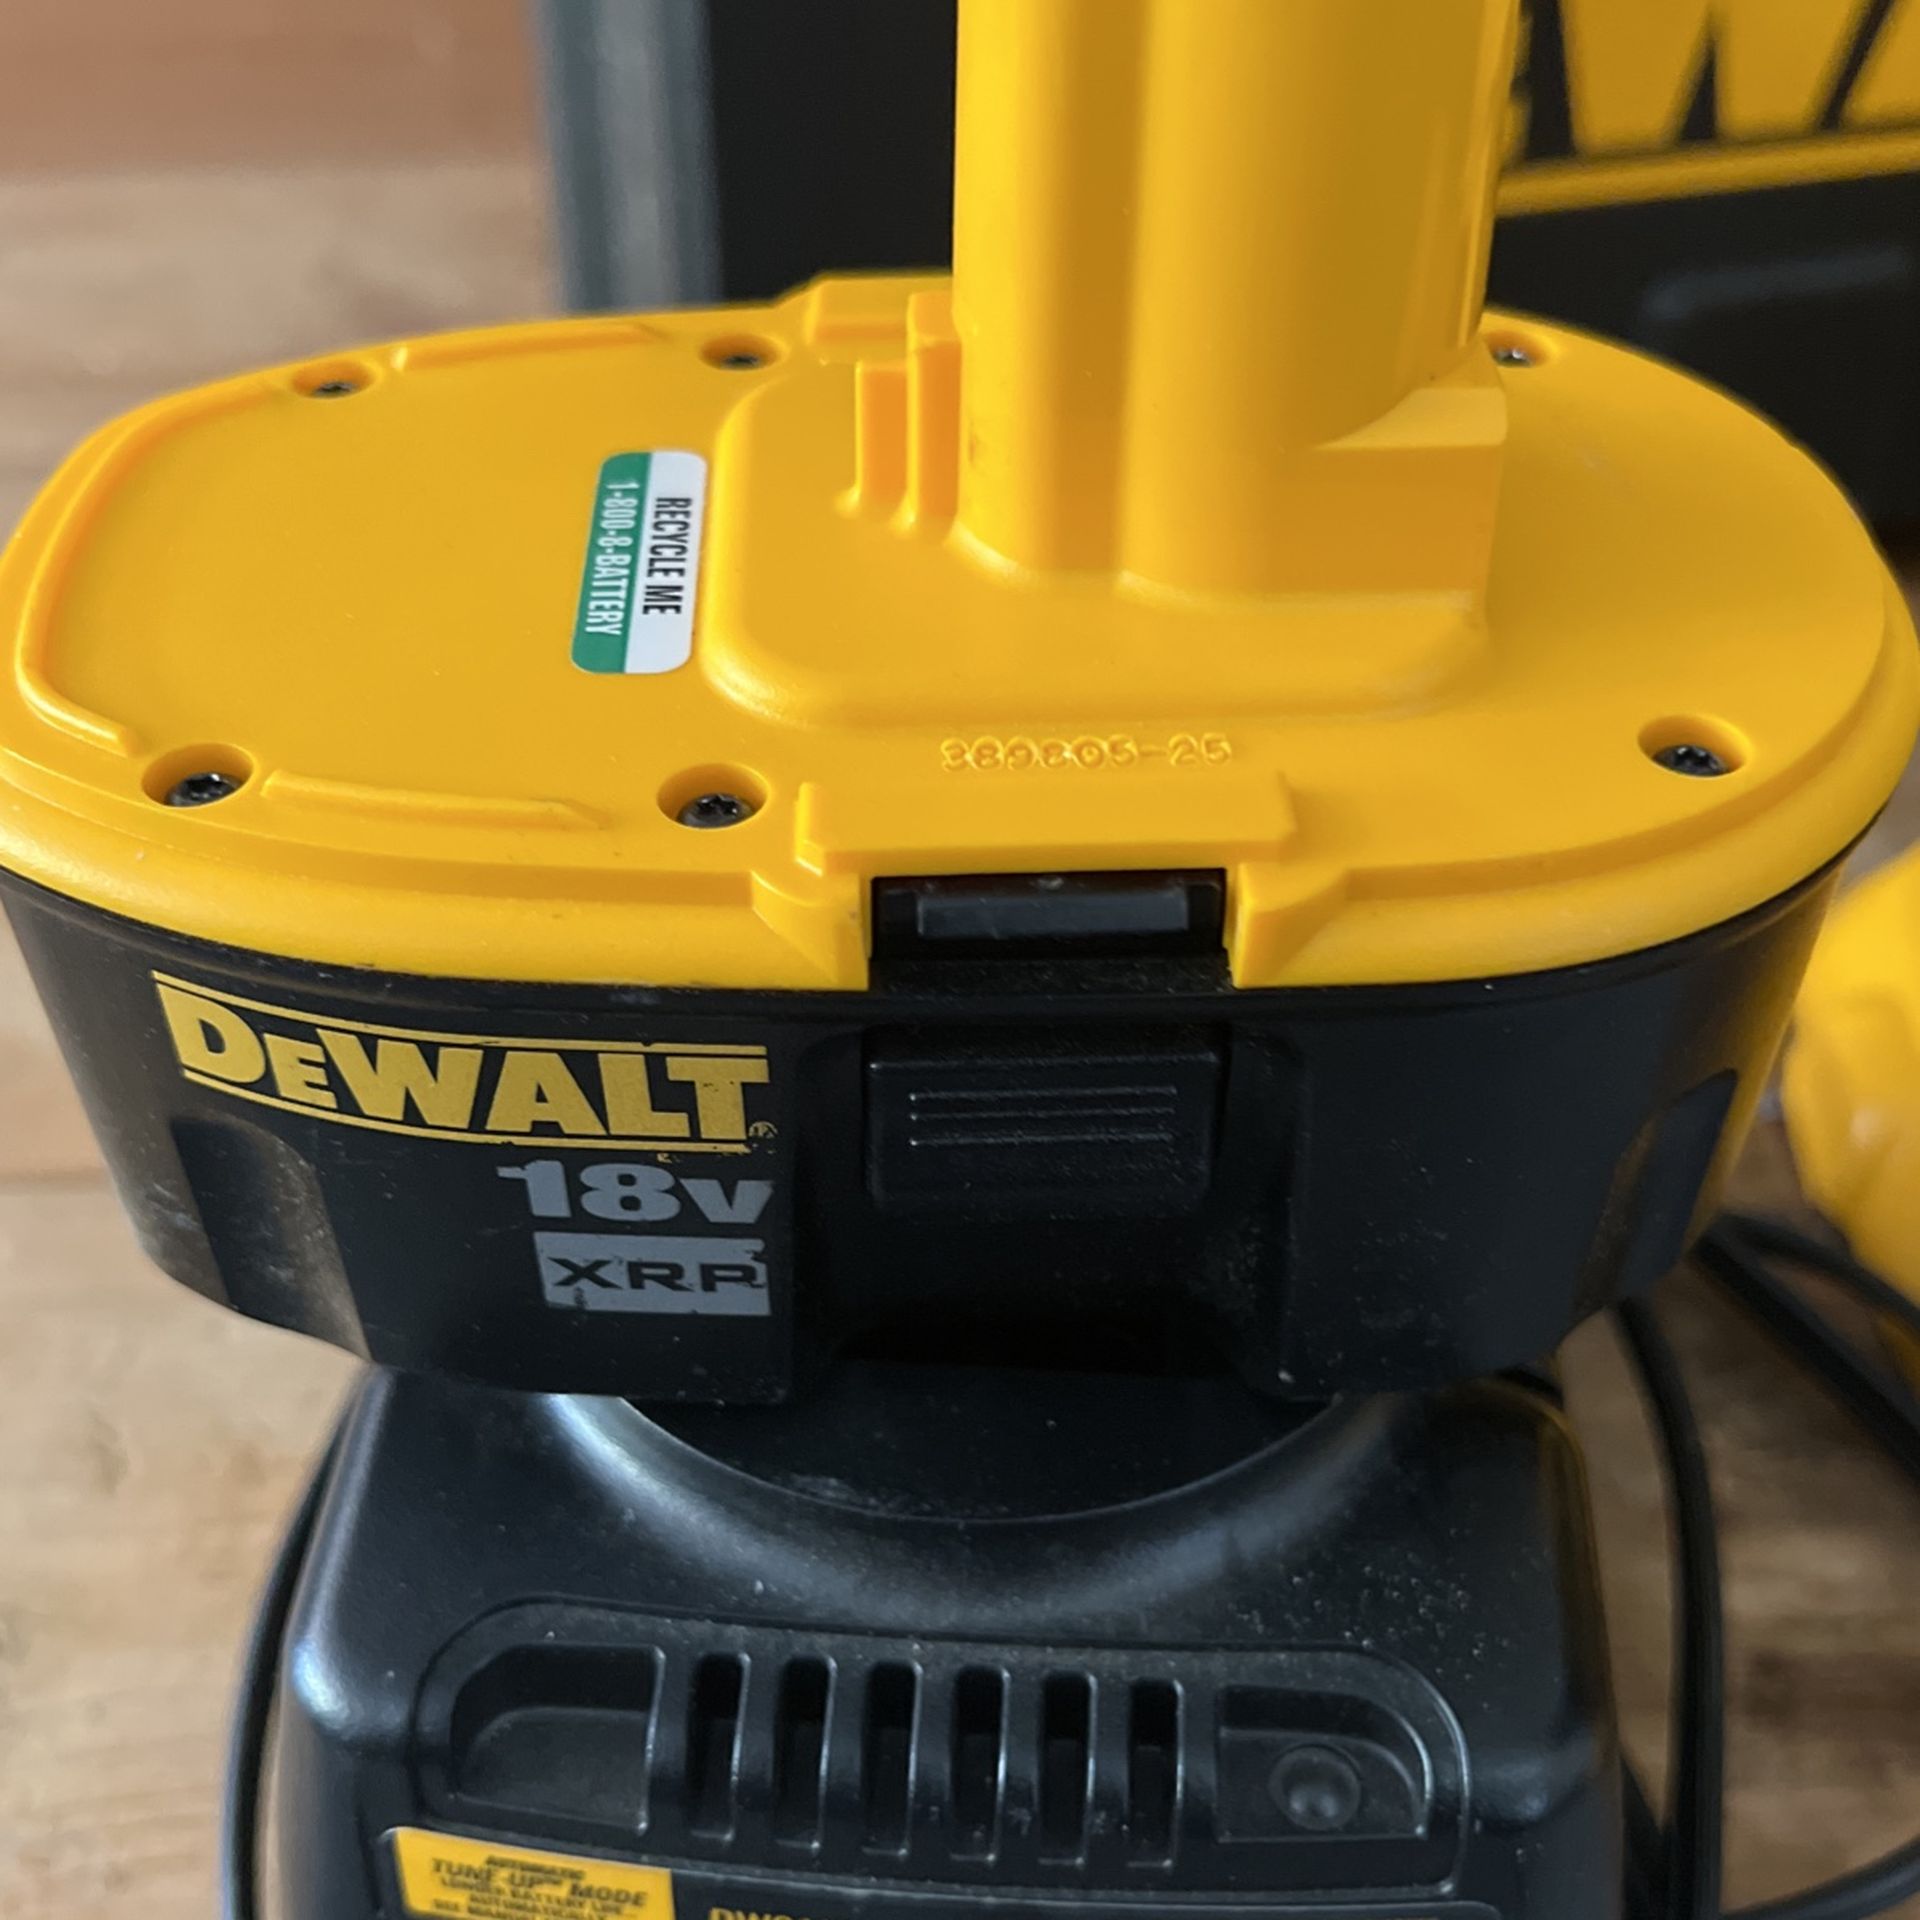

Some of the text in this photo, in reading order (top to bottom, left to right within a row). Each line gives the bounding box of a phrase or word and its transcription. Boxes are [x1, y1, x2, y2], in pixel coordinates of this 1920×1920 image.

[584, 482, 641, 636] 1-800-8-BATTERY
[642, 497, 693, 615] RECYCLE ME
[548, 1256, 767, 1293] XRP
